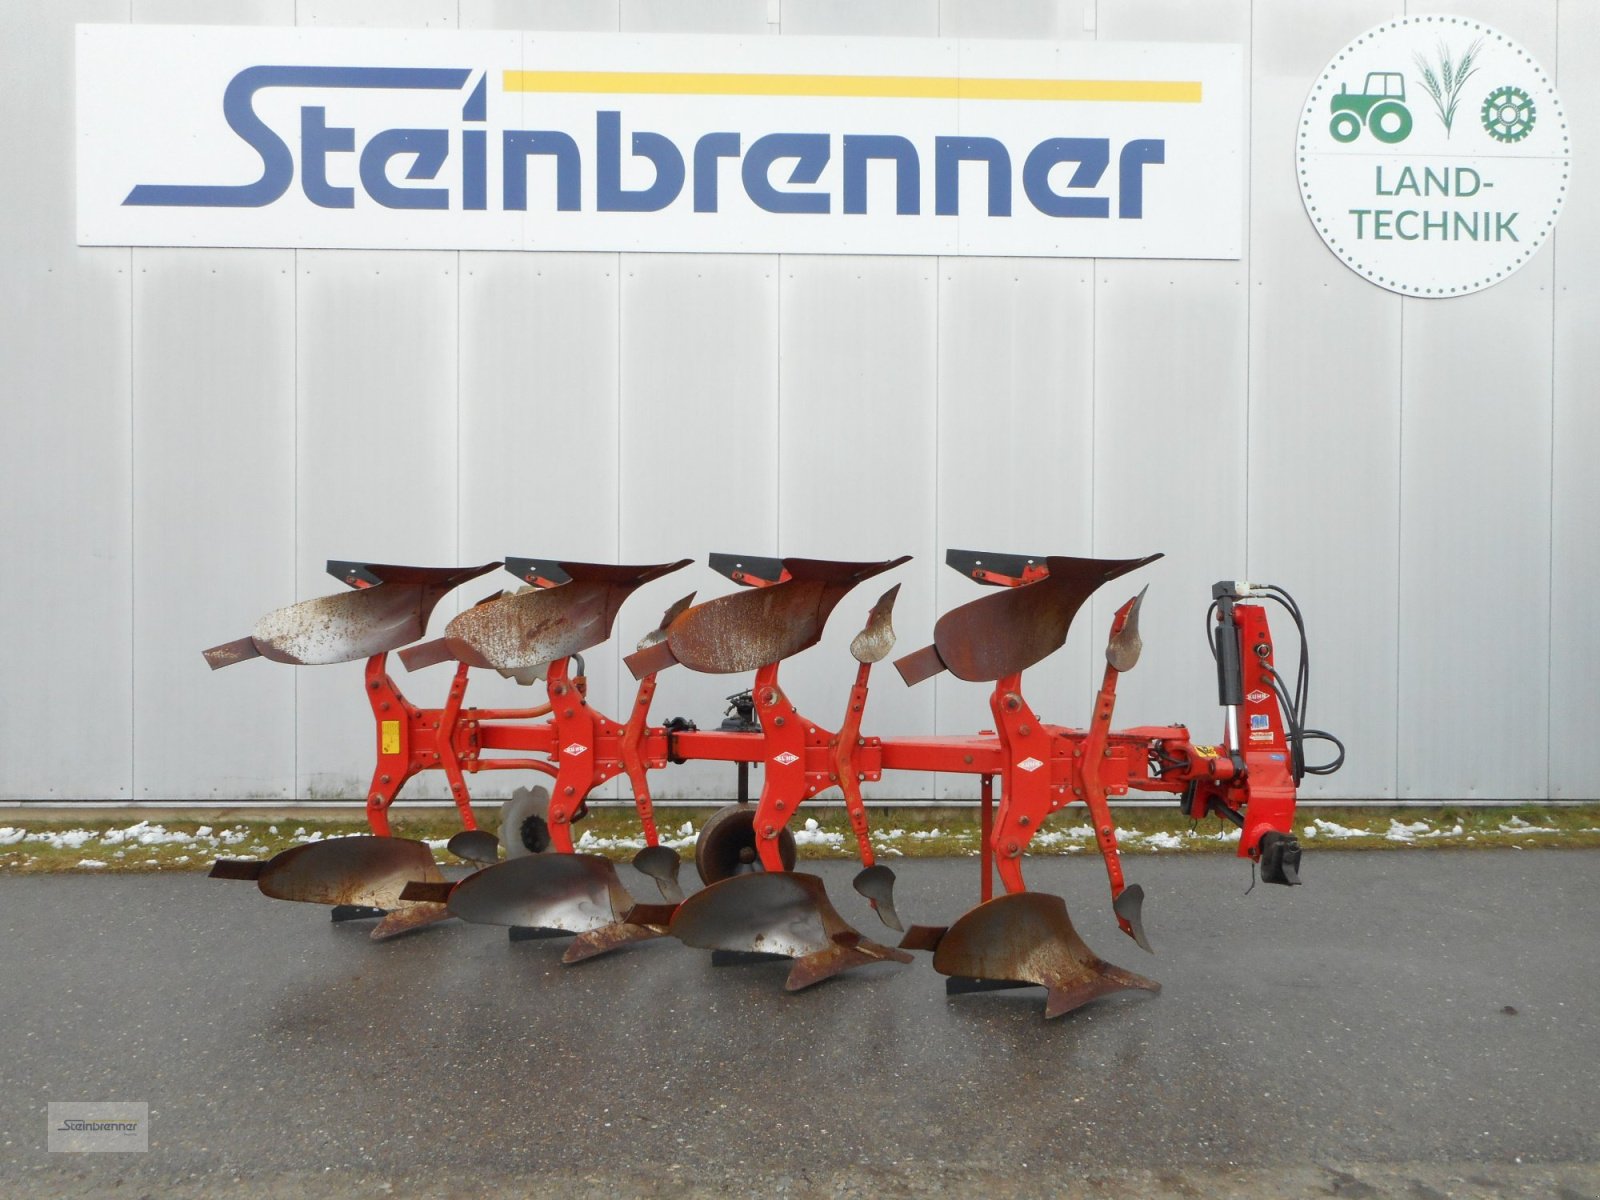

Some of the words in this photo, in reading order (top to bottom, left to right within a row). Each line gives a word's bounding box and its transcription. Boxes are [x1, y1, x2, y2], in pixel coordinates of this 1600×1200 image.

[123, 66, 1165, 219] Steinbrenner
[1375, 165, 1494, 197] LAND-
[1348, 209, 1520, 242] TECHNIK
